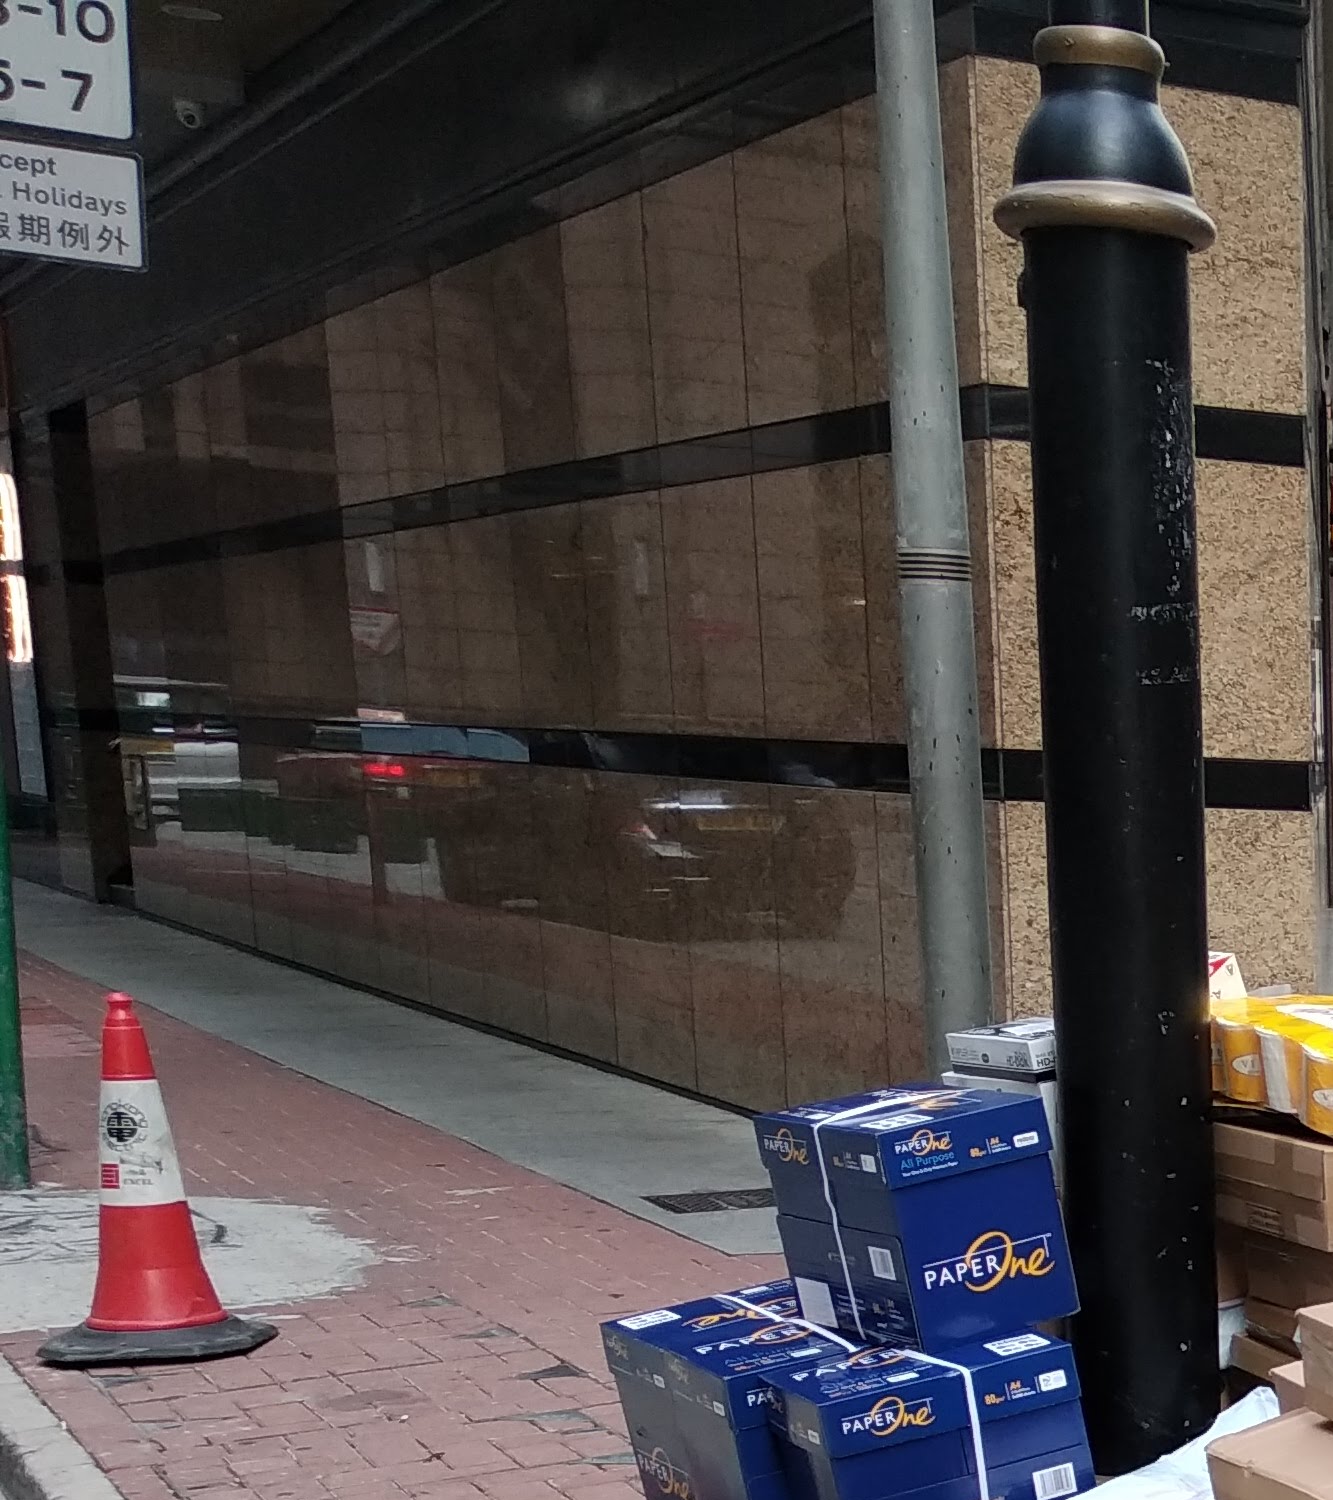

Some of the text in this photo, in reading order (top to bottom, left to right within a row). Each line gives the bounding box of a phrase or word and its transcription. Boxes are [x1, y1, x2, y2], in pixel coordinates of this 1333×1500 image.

[0, 154, 57, 177] cept
[12, 180, 128, 216] Holidays
[901, 1157, 914, 1171] All
[916, 1151, 956, 1167] Purpose
